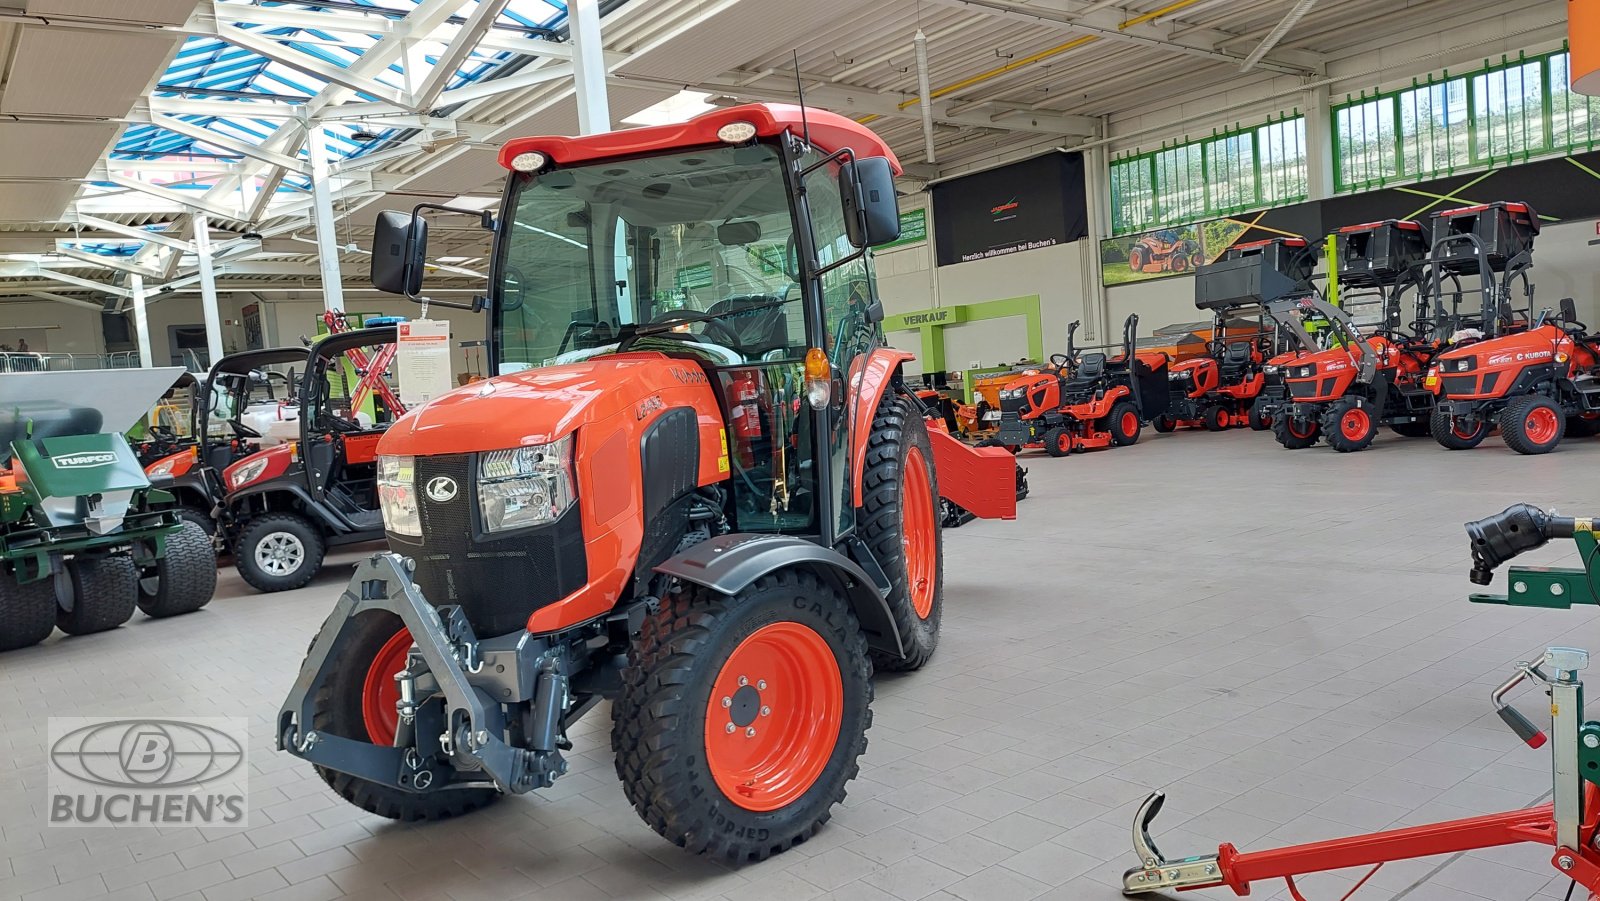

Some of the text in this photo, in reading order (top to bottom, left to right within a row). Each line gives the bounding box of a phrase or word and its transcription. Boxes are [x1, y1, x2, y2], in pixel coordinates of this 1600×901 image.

[962, 252, 984, 262] Herzlich
[985, 246, 1018, 258] willkommen
[1018, 243, 1028, 252] bei
[903, 311, 948, 326] VERKAUF
[1347, 322, 1360, 338] MX
[1525, 351, 1551, 360] KUBOTA
[57, 454, 113, 466] TURFCO
